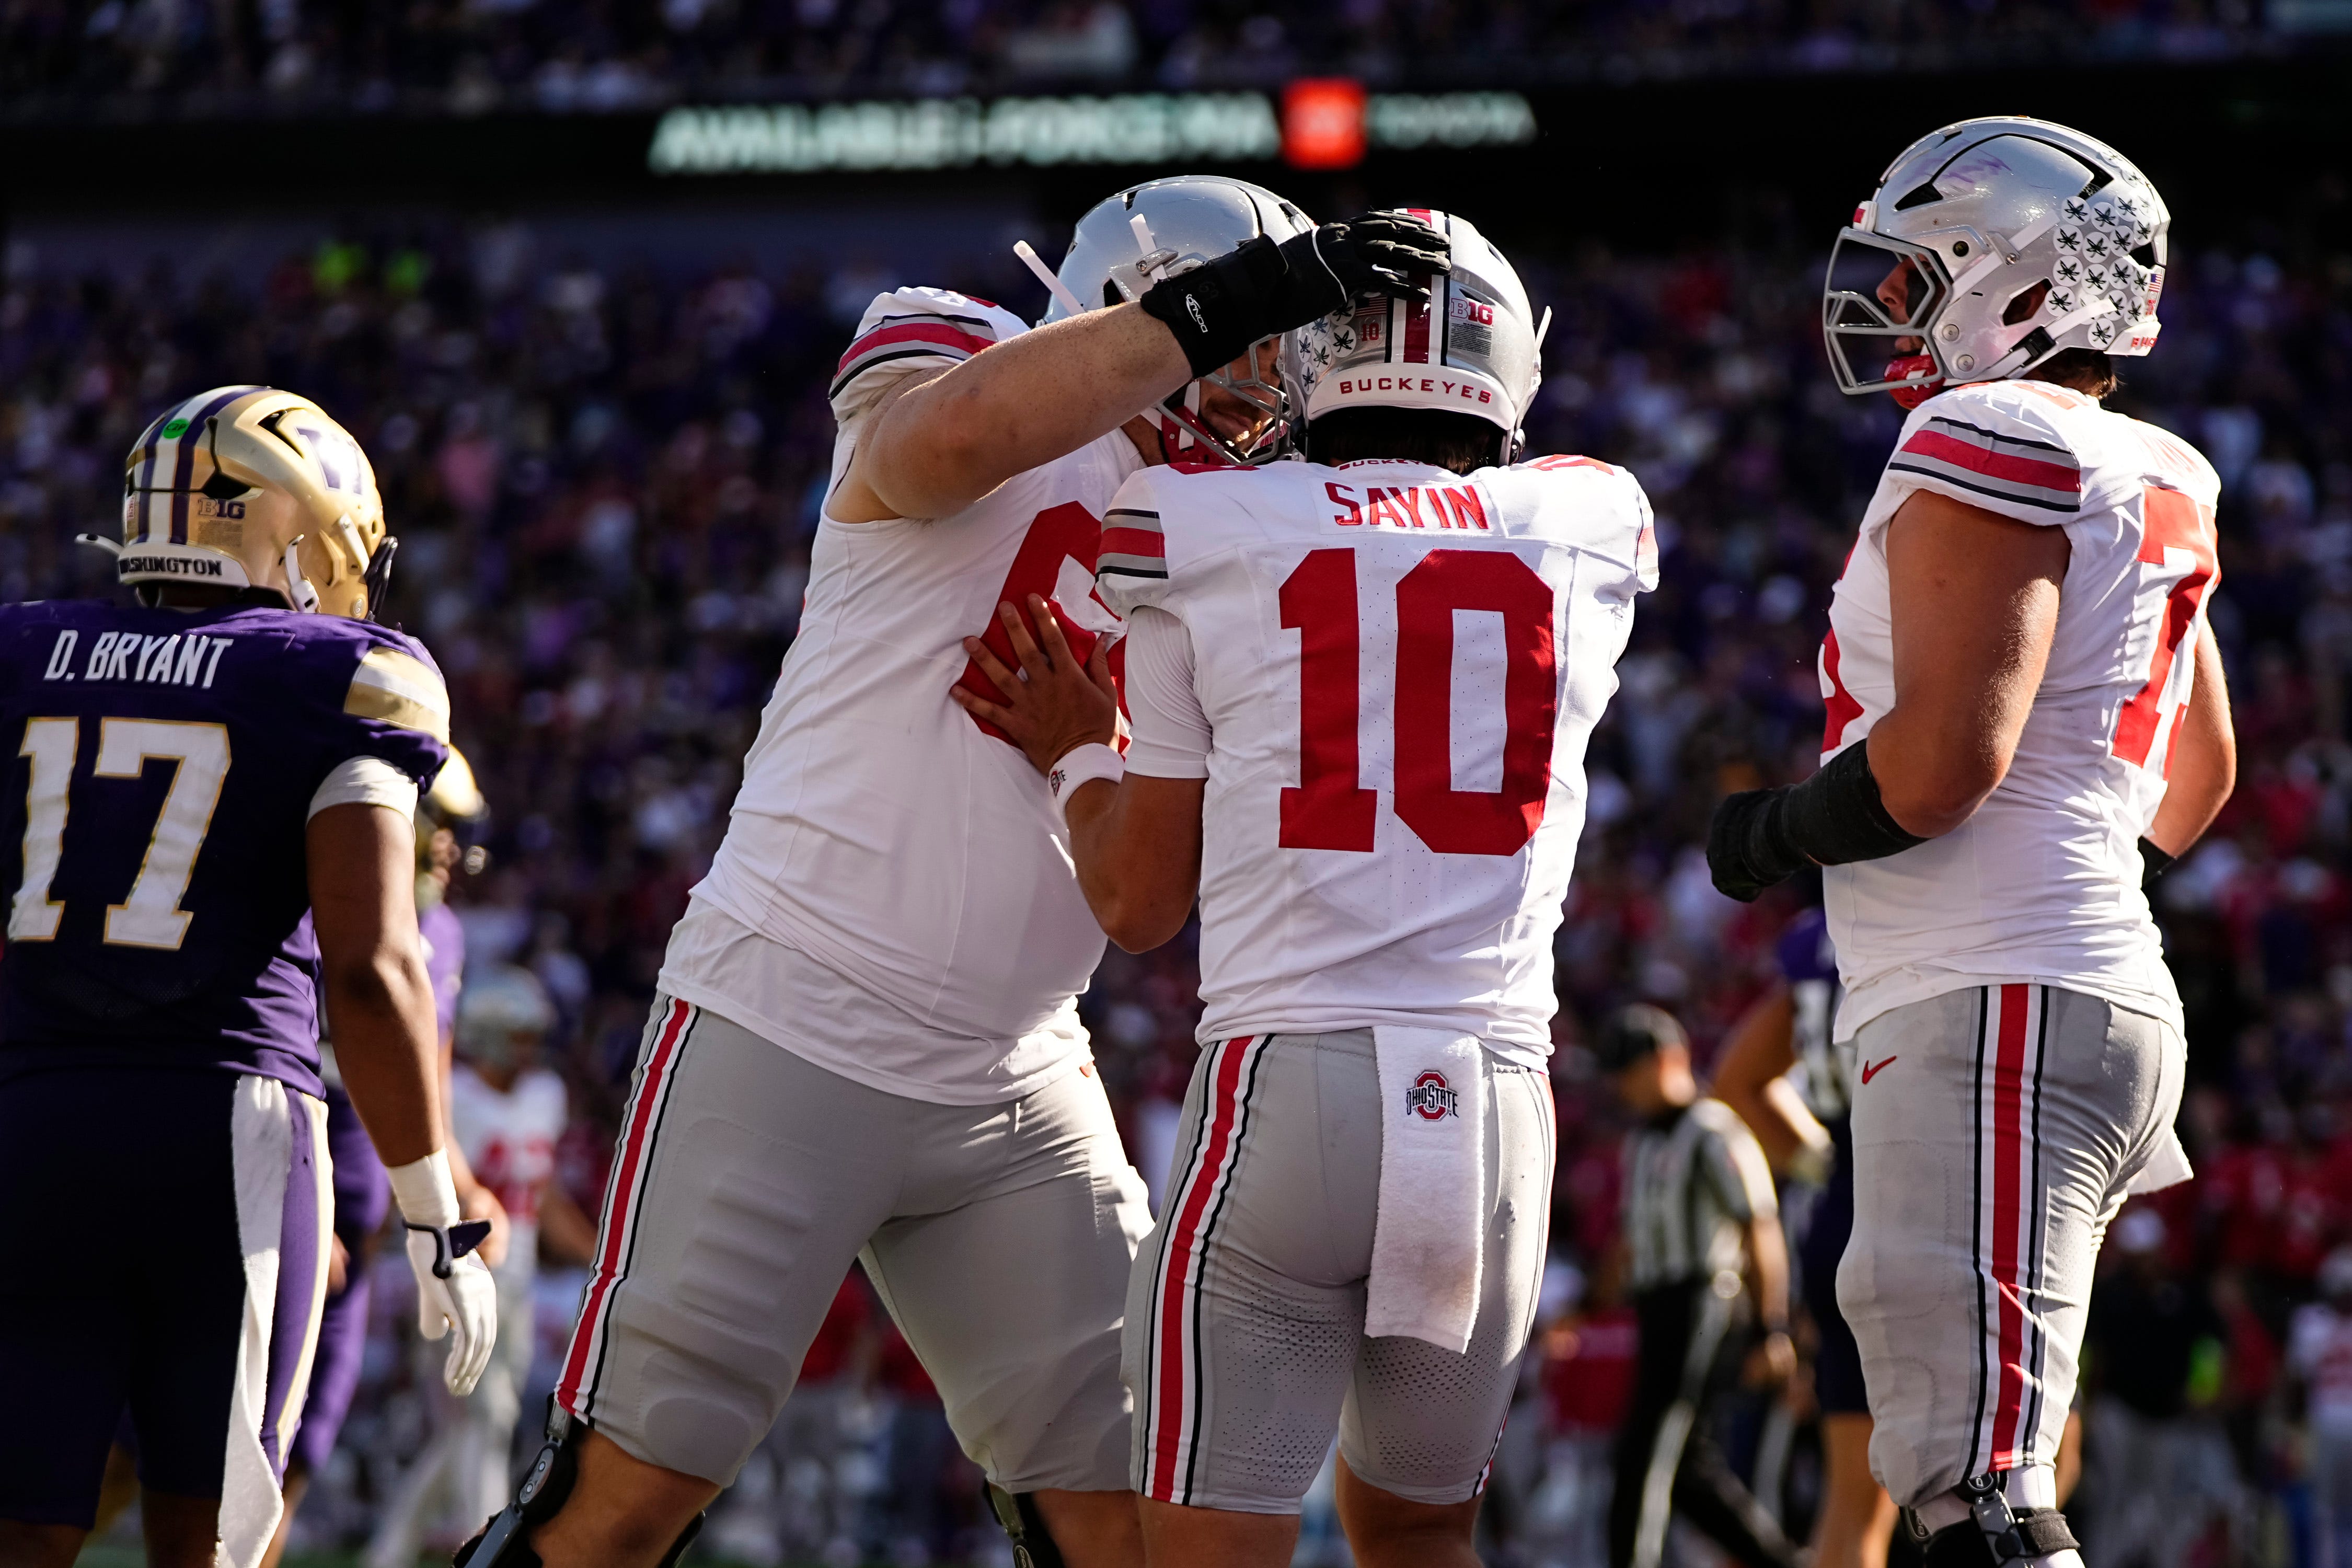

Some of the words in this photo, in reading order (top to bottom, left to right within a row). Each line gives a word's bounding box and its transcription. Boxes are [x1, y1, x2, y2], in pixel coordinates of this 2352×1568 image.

[1362, 322, 1379, 341] 10
[1340, 377, 1492, 403] BUCKEYES
[1324, 481, 1489, 529] SAYIN
[44, 629, 78, 682] D.
[84, 631, 234, 689] BRYANT
[1278, 548, 1558, 857] 10
[7, 716, 233, 951] 17
